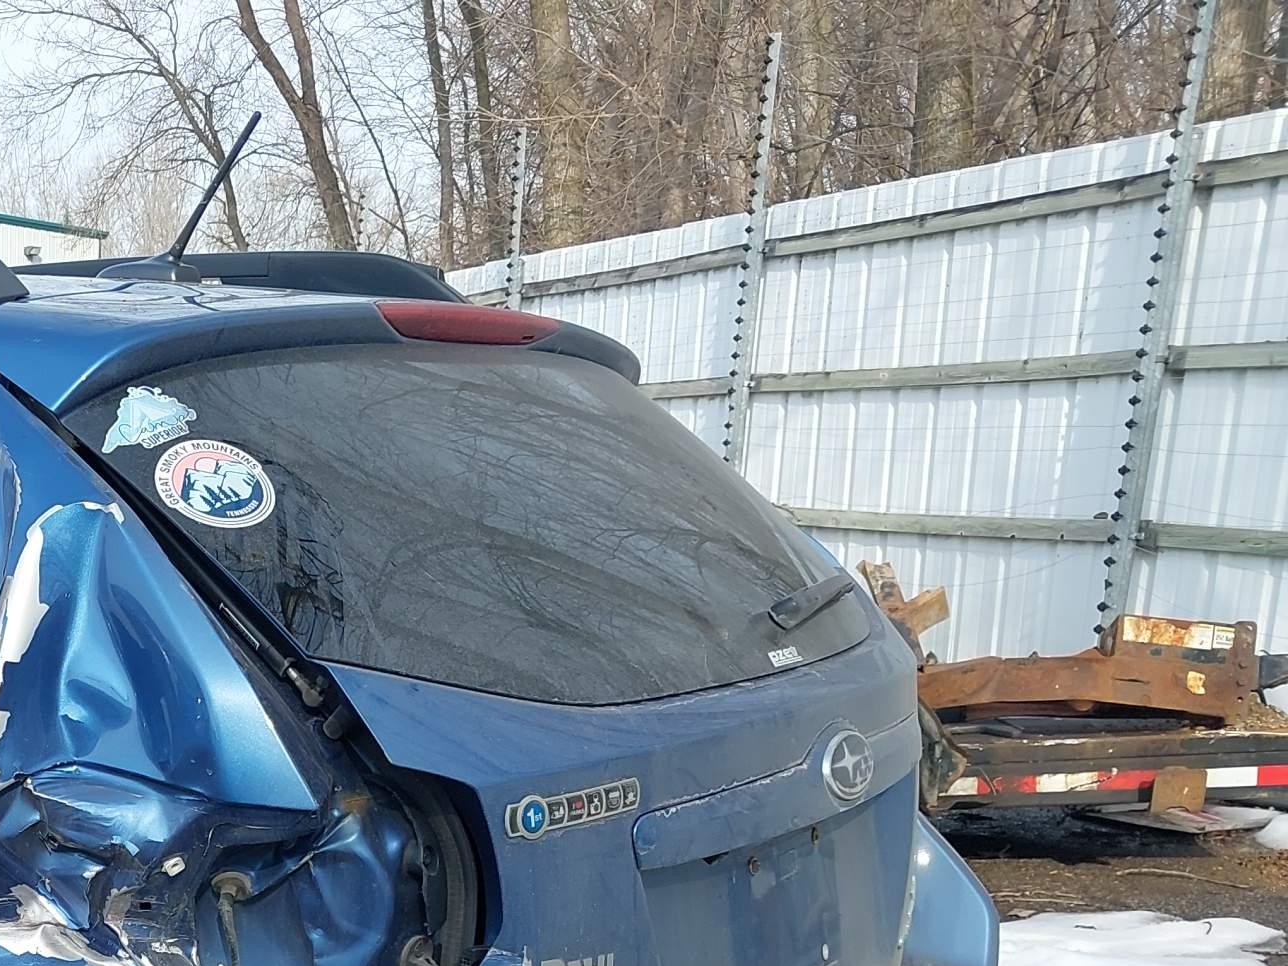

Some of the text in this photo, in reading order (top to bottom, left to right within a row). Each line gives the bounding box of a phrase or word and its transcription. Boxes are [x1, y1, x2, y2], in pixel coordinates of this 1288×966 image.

[141, 425, 187, 448] SUPERIOR
[158, 442, 259, 506] GREAT SMOKY MOUNTAINS
[526, 807, 543, 828] 1st
